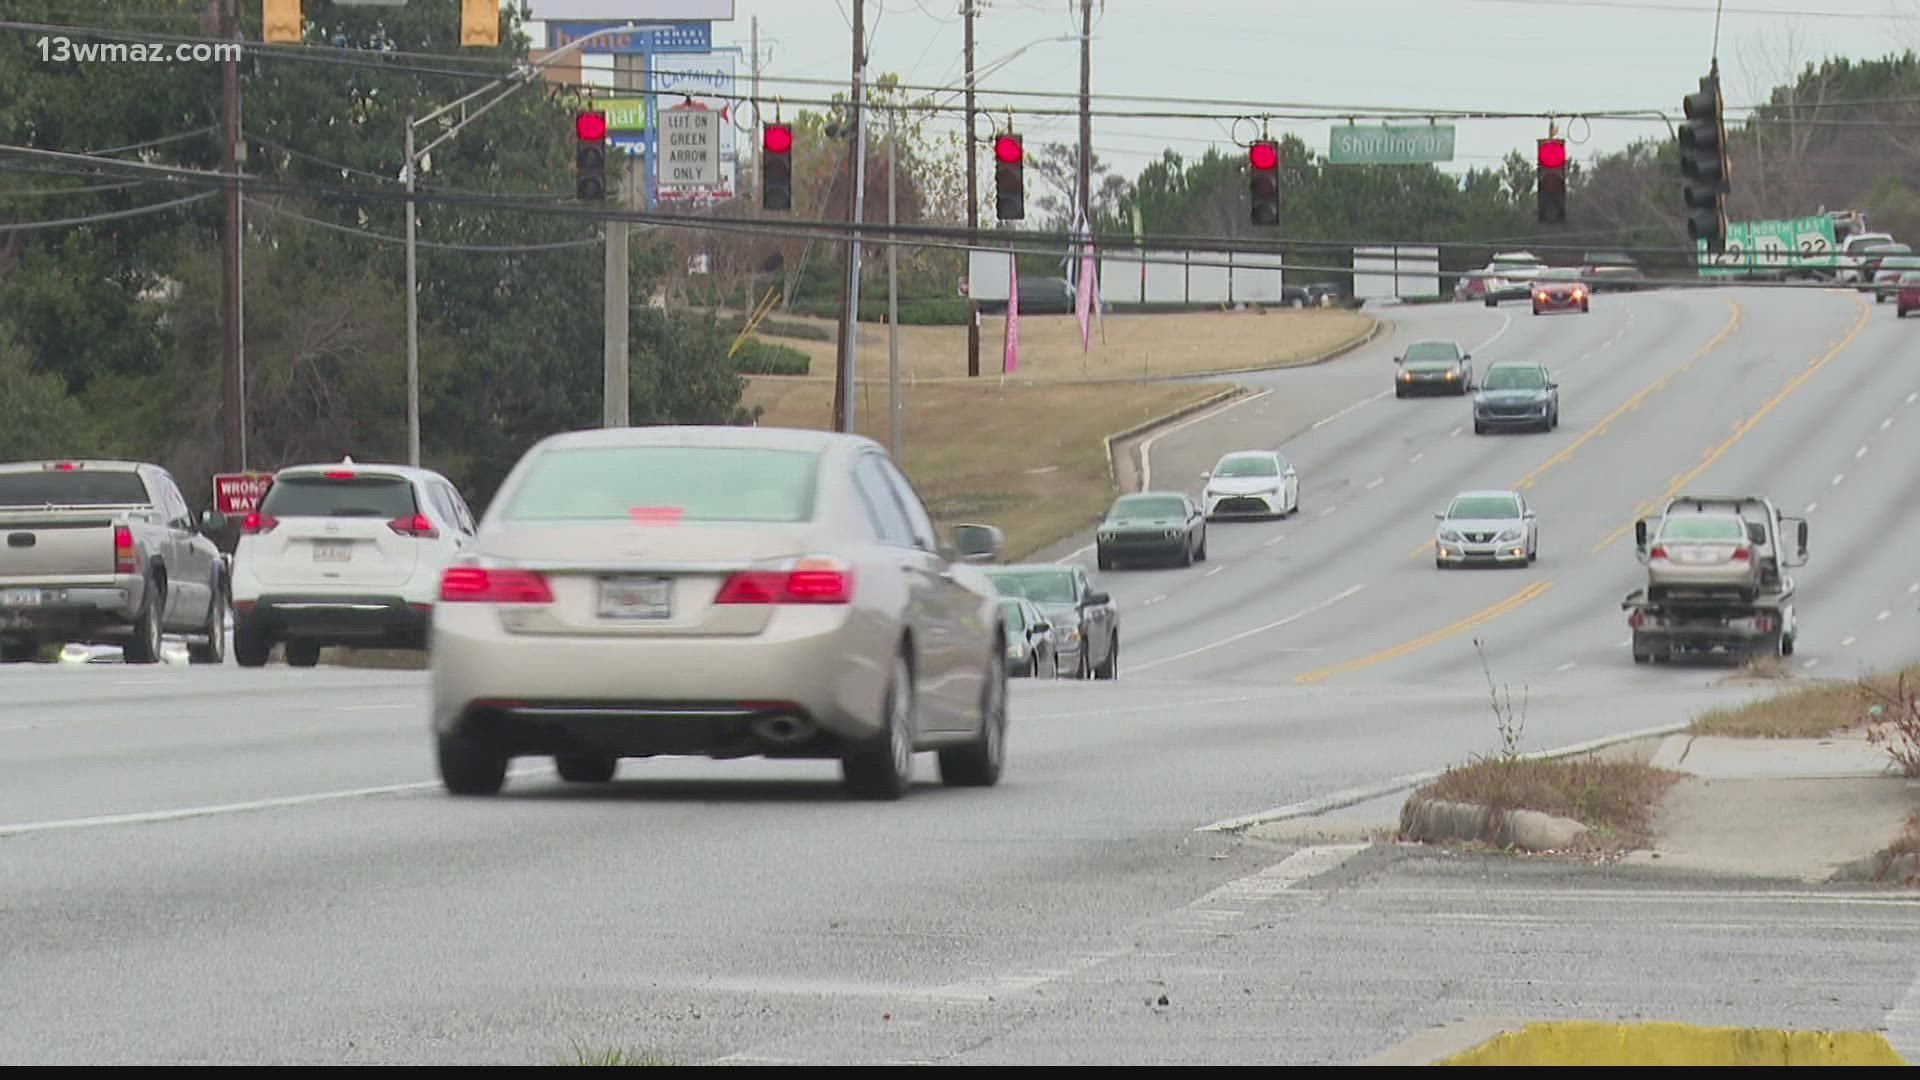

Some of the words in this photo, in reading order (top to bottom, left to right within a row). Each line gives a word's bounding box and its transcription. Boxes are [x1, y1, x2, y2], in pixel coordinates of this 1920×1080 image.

[668, 116, 689, 128] LEFT
[695, 116, 707, 128] ON
[670, 135, 706, 146] GREEN
[1341, 135, 1415, 157] Shurling
[1424, 135, 1442, 153] Dr
[669, 152, 707, 163] ARROW
[673, 167, 703, 180] ONLY
[1752, 223, 1790, 236] NORTH
[1798, 217, 1824, 231] EAST
[1801, 239, 1826, 258] 22
[221, 481, 267, 495] WRONG
[230, 497, 257, 510] WAY
